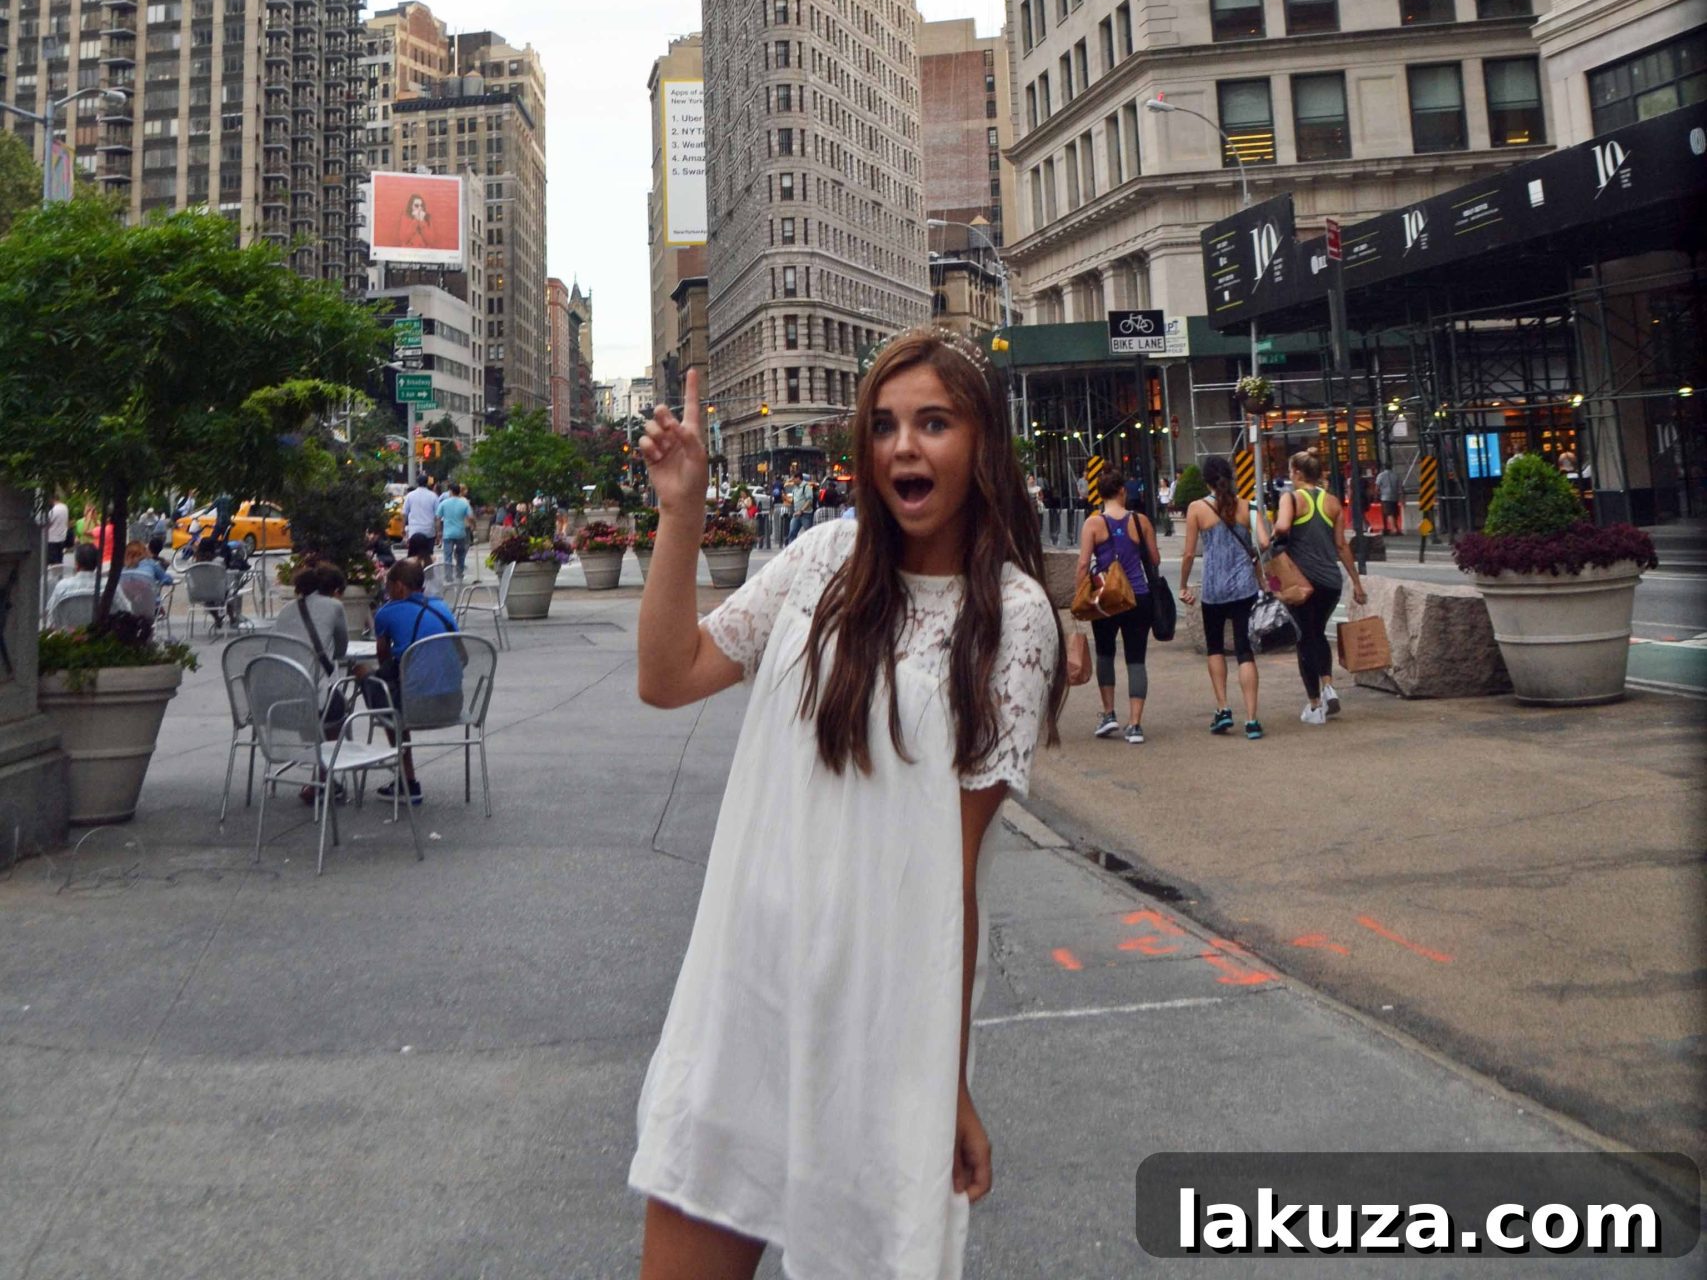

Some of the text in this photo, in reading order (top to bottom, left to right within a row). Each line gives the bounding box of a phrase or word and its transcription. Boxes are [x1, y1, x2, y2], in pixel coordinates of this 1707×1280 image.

[671, 89, 688, 97] Apps
[682, 114, 703, 122] Uber
[1591, 140, 1625, 189] 10
[1402, 210, 1426, 249] 10
[1249, 223, 1280, 280] 10
[1113, 339, 1134, 350] BIKE
[1138, 337, 1164, 349] LANE
[406, 379, 431, 387] Broadway
